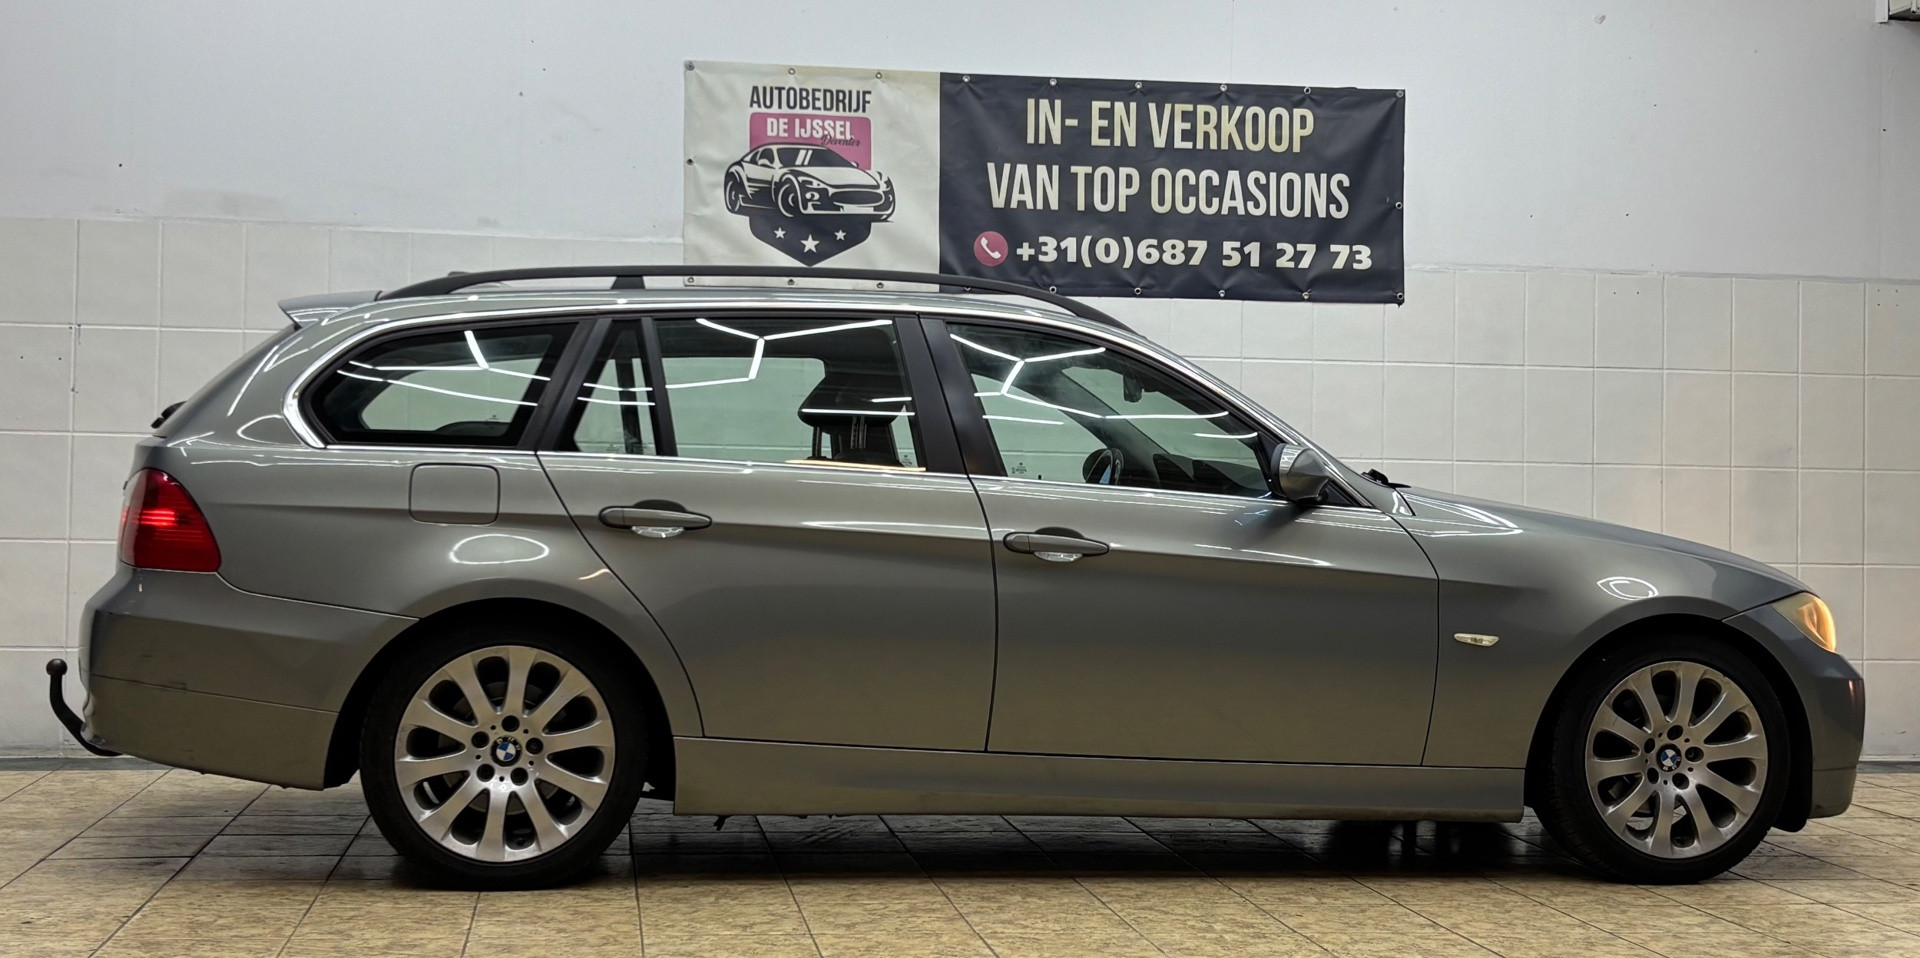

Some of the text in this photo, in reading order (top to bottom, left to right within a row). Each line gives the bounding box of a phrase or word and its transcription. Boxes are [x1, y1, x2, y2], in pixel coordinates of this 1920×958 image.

[750, 85, 872, 113] AUTOBEDRIJF
[767, 117, 854, 139] DE IJSSEL
[1026, 98, 1314, 153] IN- EN VERKOOP
[986, 162, 1350, 219] VAN TOP OCCASIONS
[1016, 235, 1372, 270] +31(0)687 51 27 73
